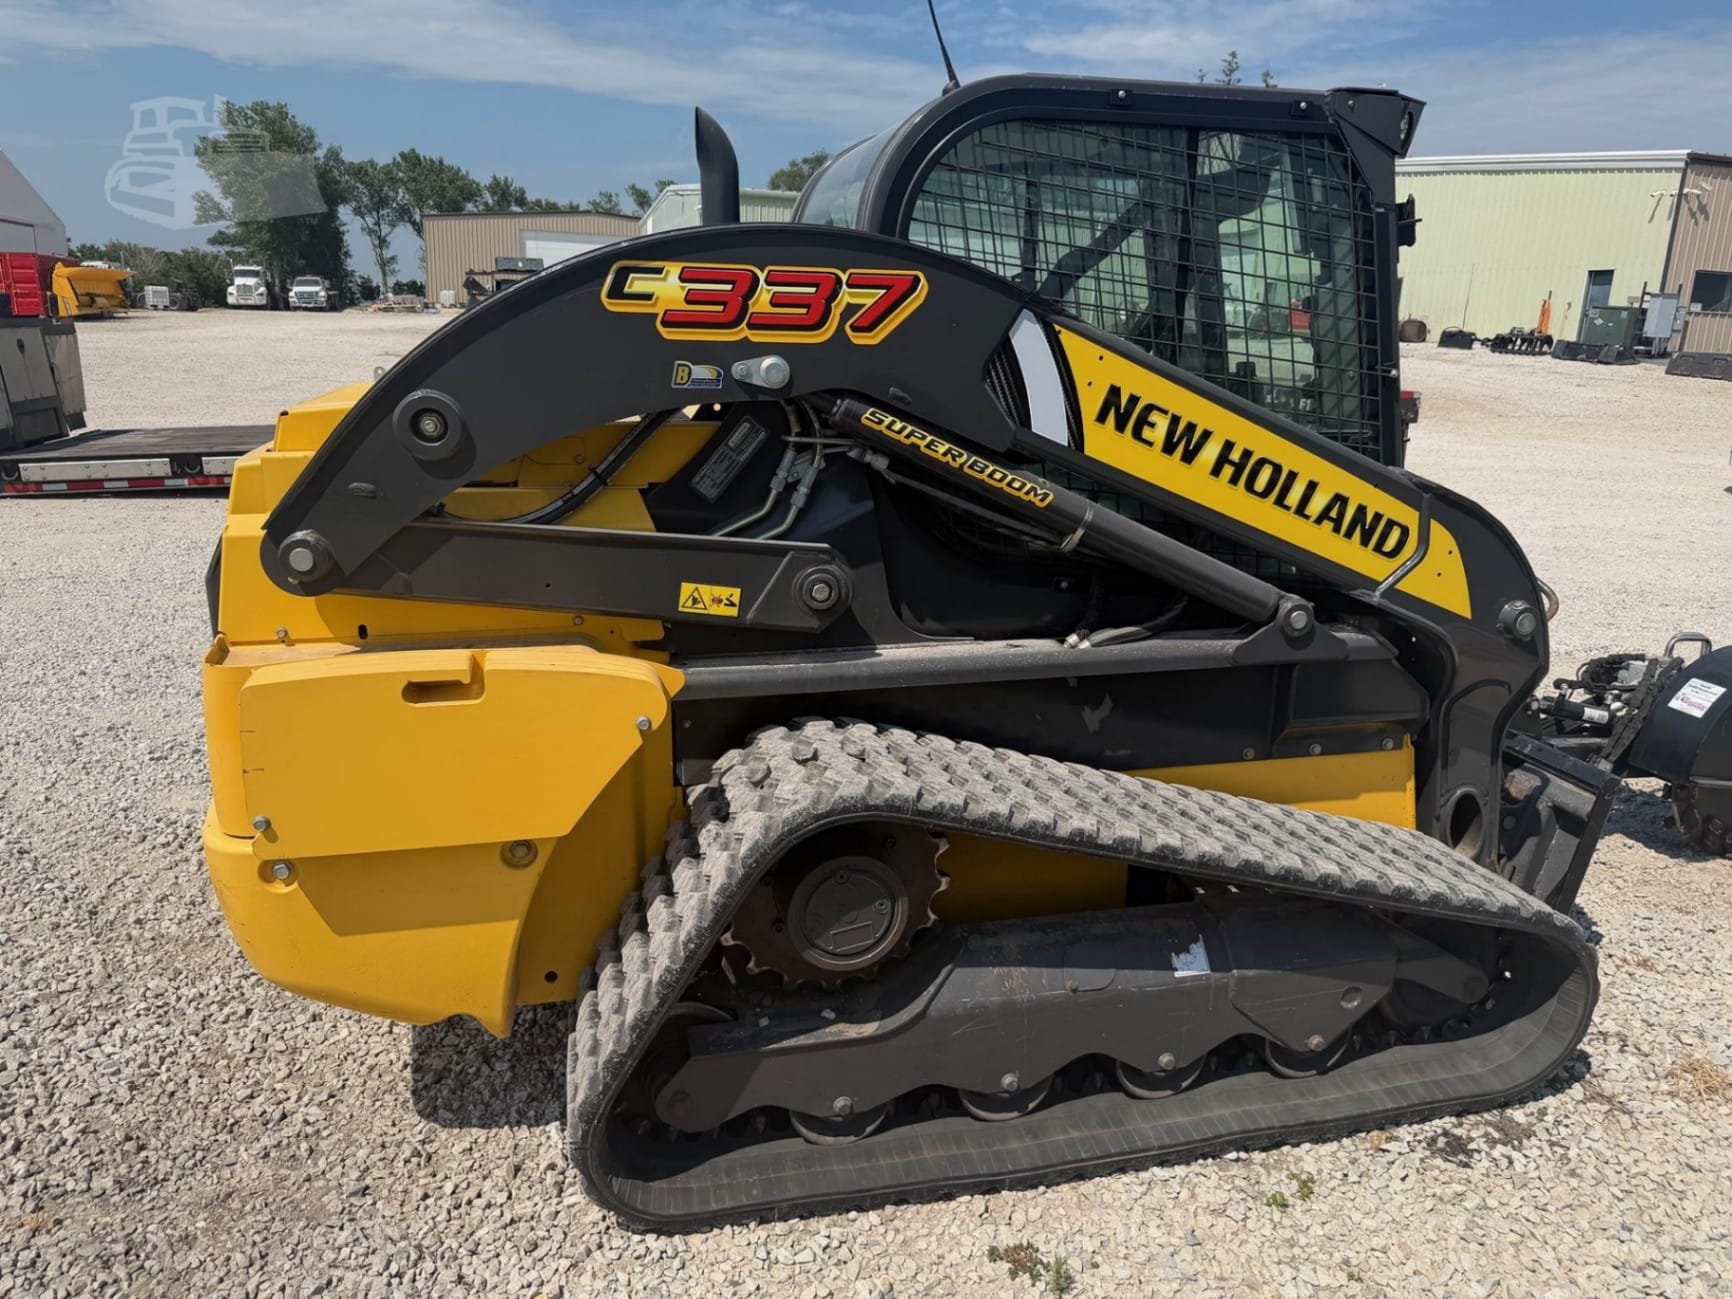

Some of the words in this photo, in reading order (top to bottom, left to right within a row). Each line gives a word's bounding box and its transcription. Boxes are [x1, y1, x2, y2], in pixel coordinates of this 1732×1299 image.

[862, 409, 967, 466] SUPER
[964, 456, 1054, 508] BOOM
[1094, 383, 1215, 466] NEW
[1208, 438, 1411, 560] HOLLAND
